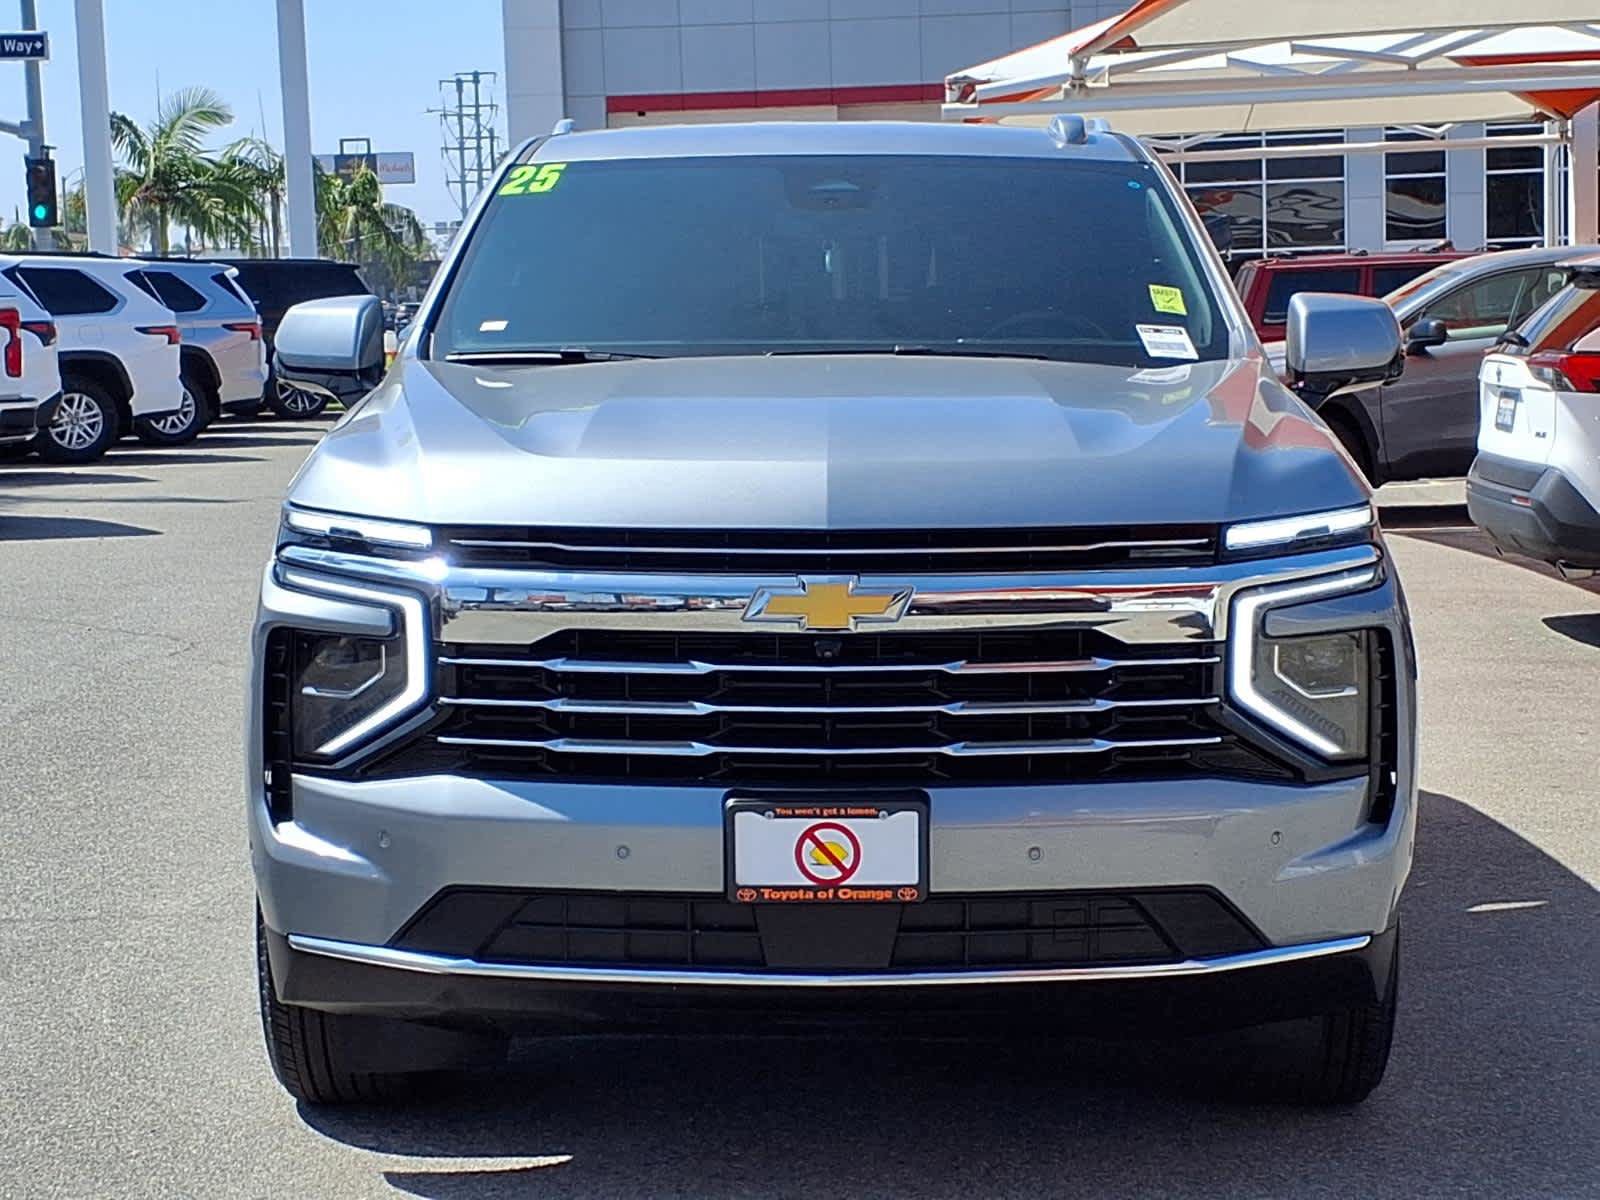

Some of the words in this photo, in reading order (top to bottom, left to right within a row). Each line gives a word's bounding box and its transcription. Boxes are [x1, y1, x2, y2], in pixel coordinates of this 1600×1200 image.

[3, 39, 33, 55] Way
[498, 163, 567, 195] 25
[775, 807, 792, 816] You
[794, 807, 820, 816] won't
[822, 807, 837, 817] get
[839, 808, 846, 816] a
[760, 888, 813, 900] Toyota
[817, 888, 834, 899] of
[838, 888, 893, 900] Orange
